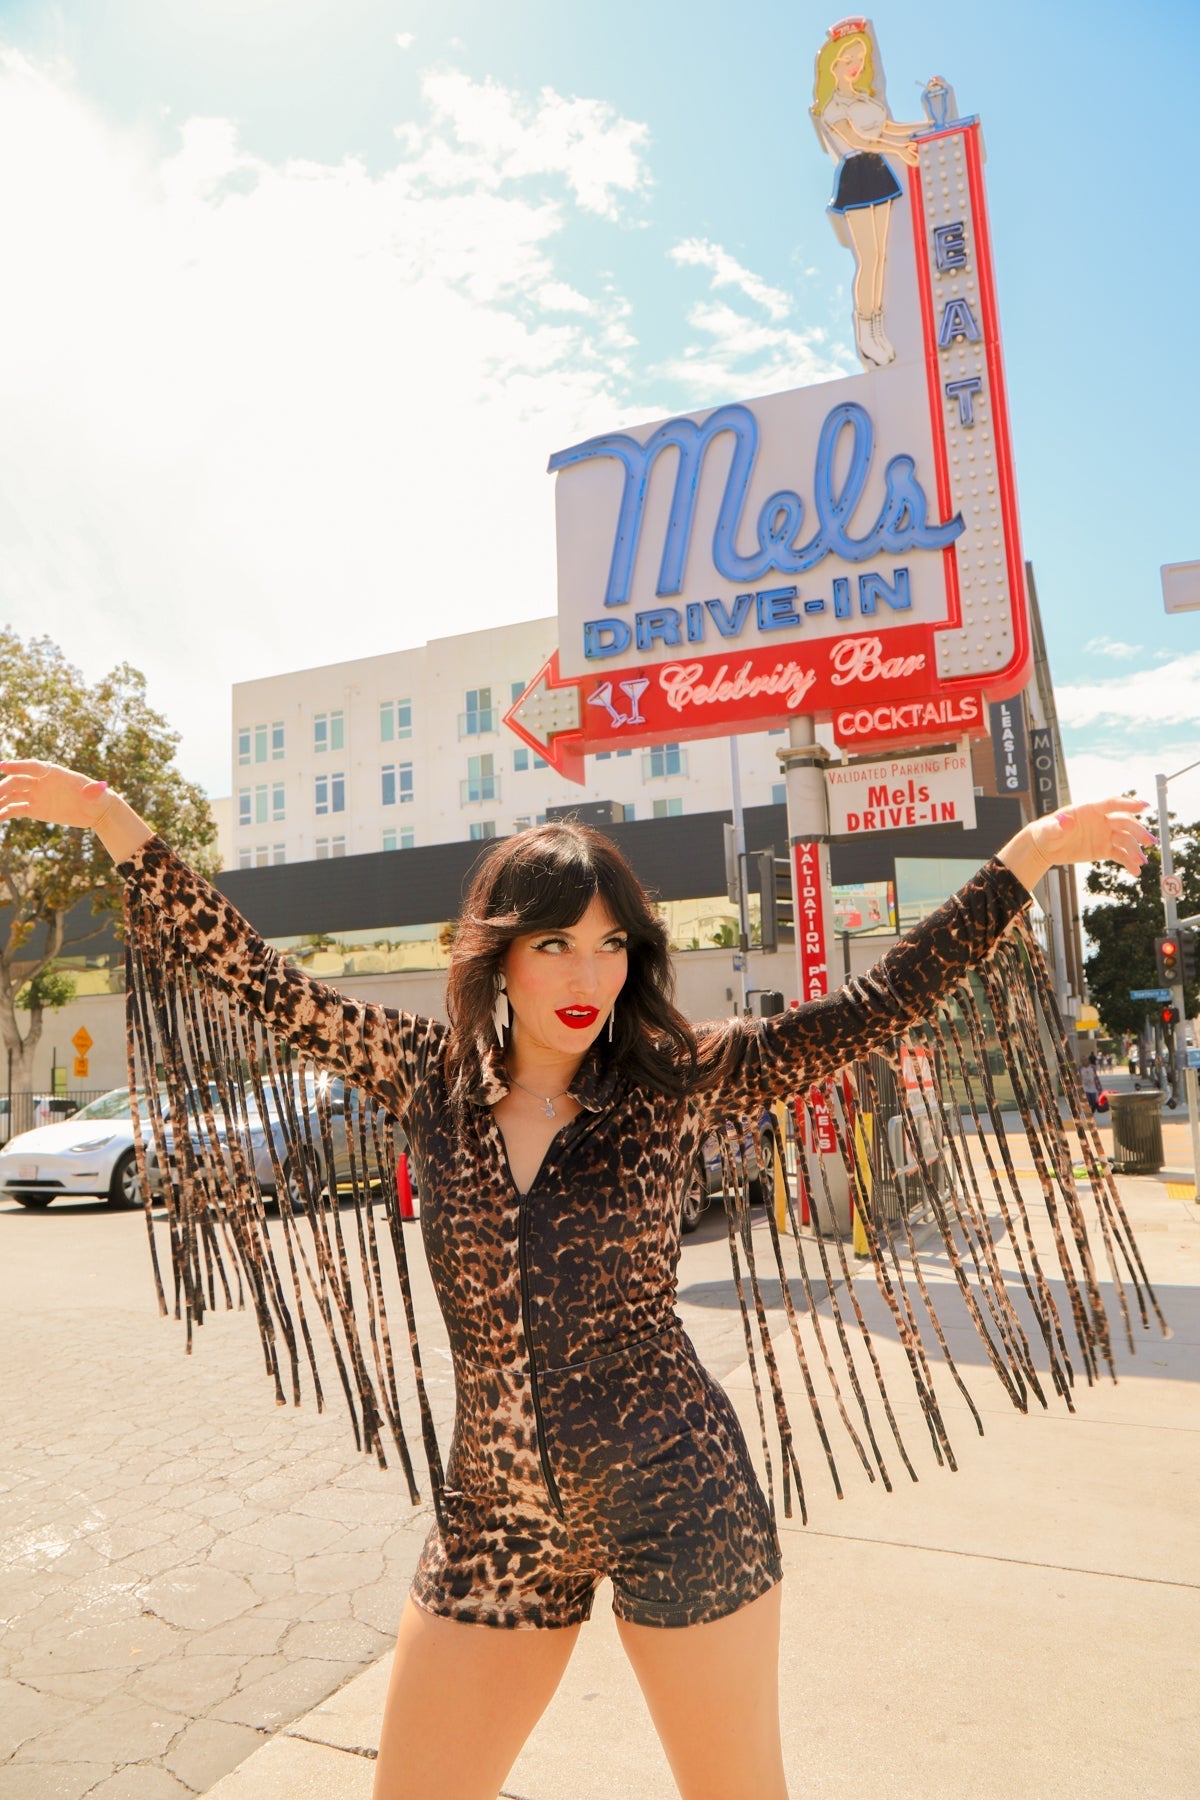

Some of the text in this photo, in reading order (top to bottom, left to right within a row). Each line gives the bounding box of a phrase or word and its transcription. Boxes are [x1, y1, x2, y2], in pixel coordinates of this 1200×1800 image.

[933, 222, 981, 428] EAT
[547, 402, 966, 607] Mels
[583, 567, 912, 660] DRIVE-IN
[658, 635, 926, 712] Celebrity Bar
[838, 697, 978, 735] COCKTAILS
[1000, 704, 1019, 789] LEASING
[828, 757, 967, 785] VALIDATED PARKING FOR
[868, 779, 930, 808] Mels
[847, 801, 956, 832] DRIVE-IN
[801, 843, 820, 954] VALIDATION
[815, 1104, 831, 1150] MELS
